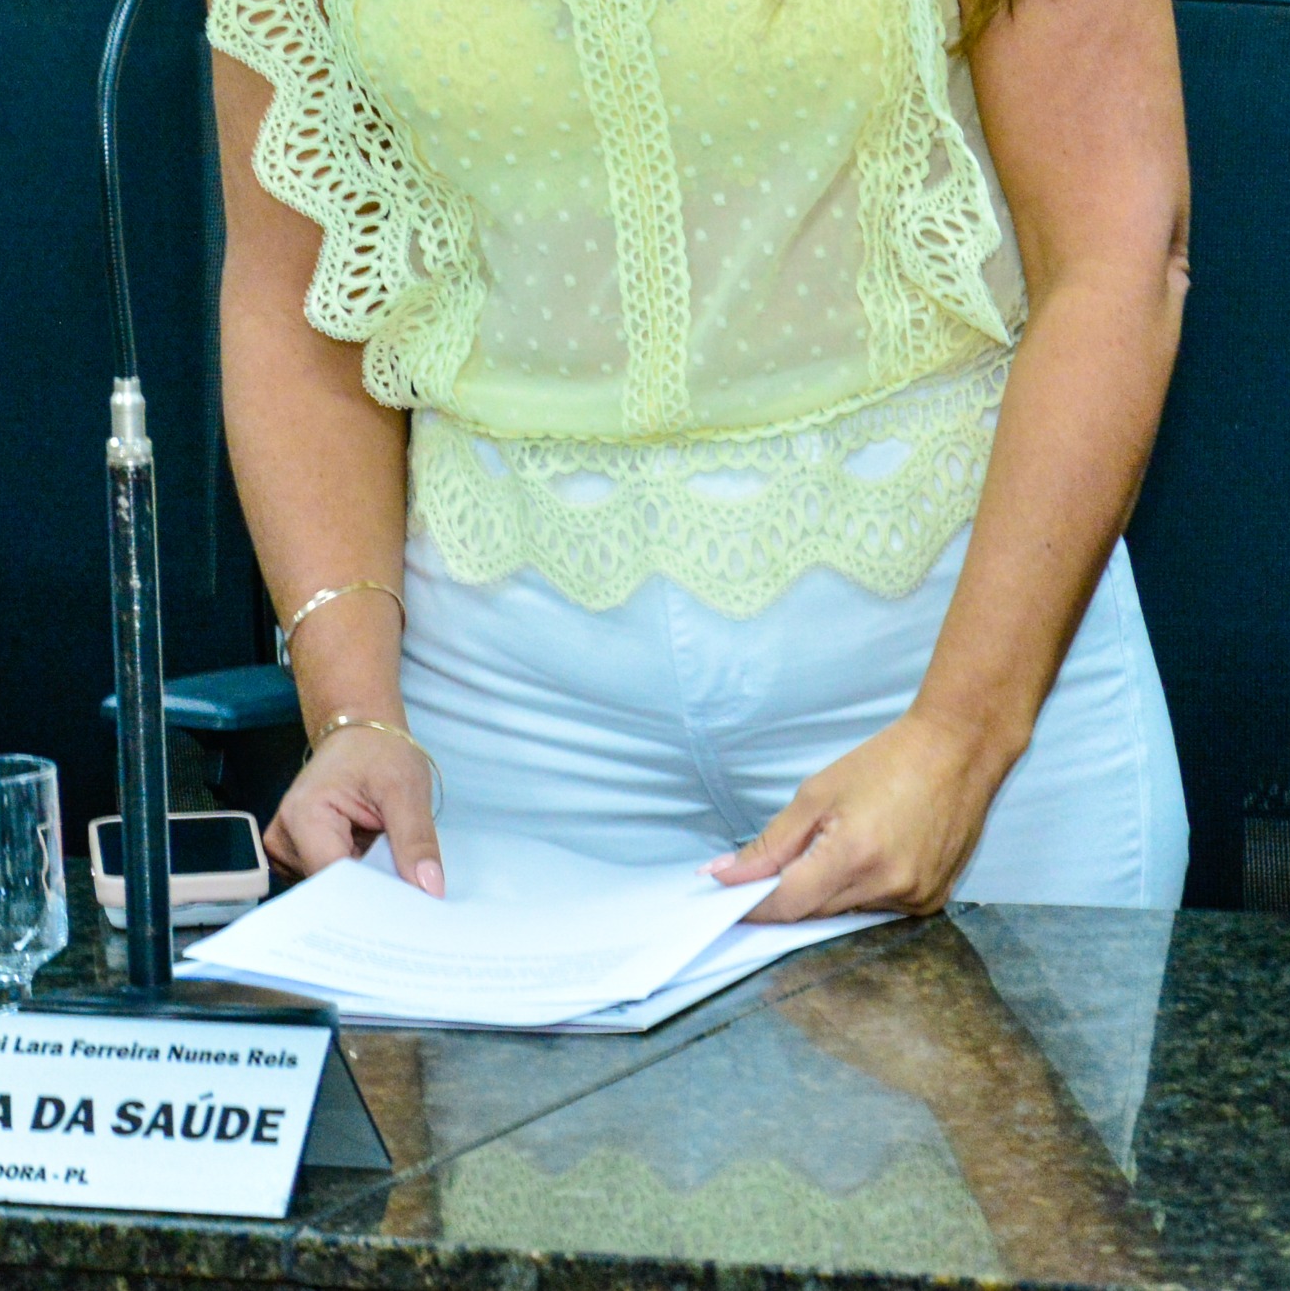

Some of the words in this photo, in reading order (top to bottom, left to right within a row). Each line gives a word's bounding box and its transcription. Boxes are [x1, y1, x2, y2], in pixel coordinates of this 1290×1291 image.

[14, 1036, 63, 1056] Lara
[70, 1039, 160, 1061] Ferreira
[167, 1044, 239, 1066] Nunes
[247, 1048, 298, 1068] Reis
[30, 1095, 95, 1134] DA
[111, 1092, 286, 1145] SAÚDE
[64, 1167, 89, 1185] PL
